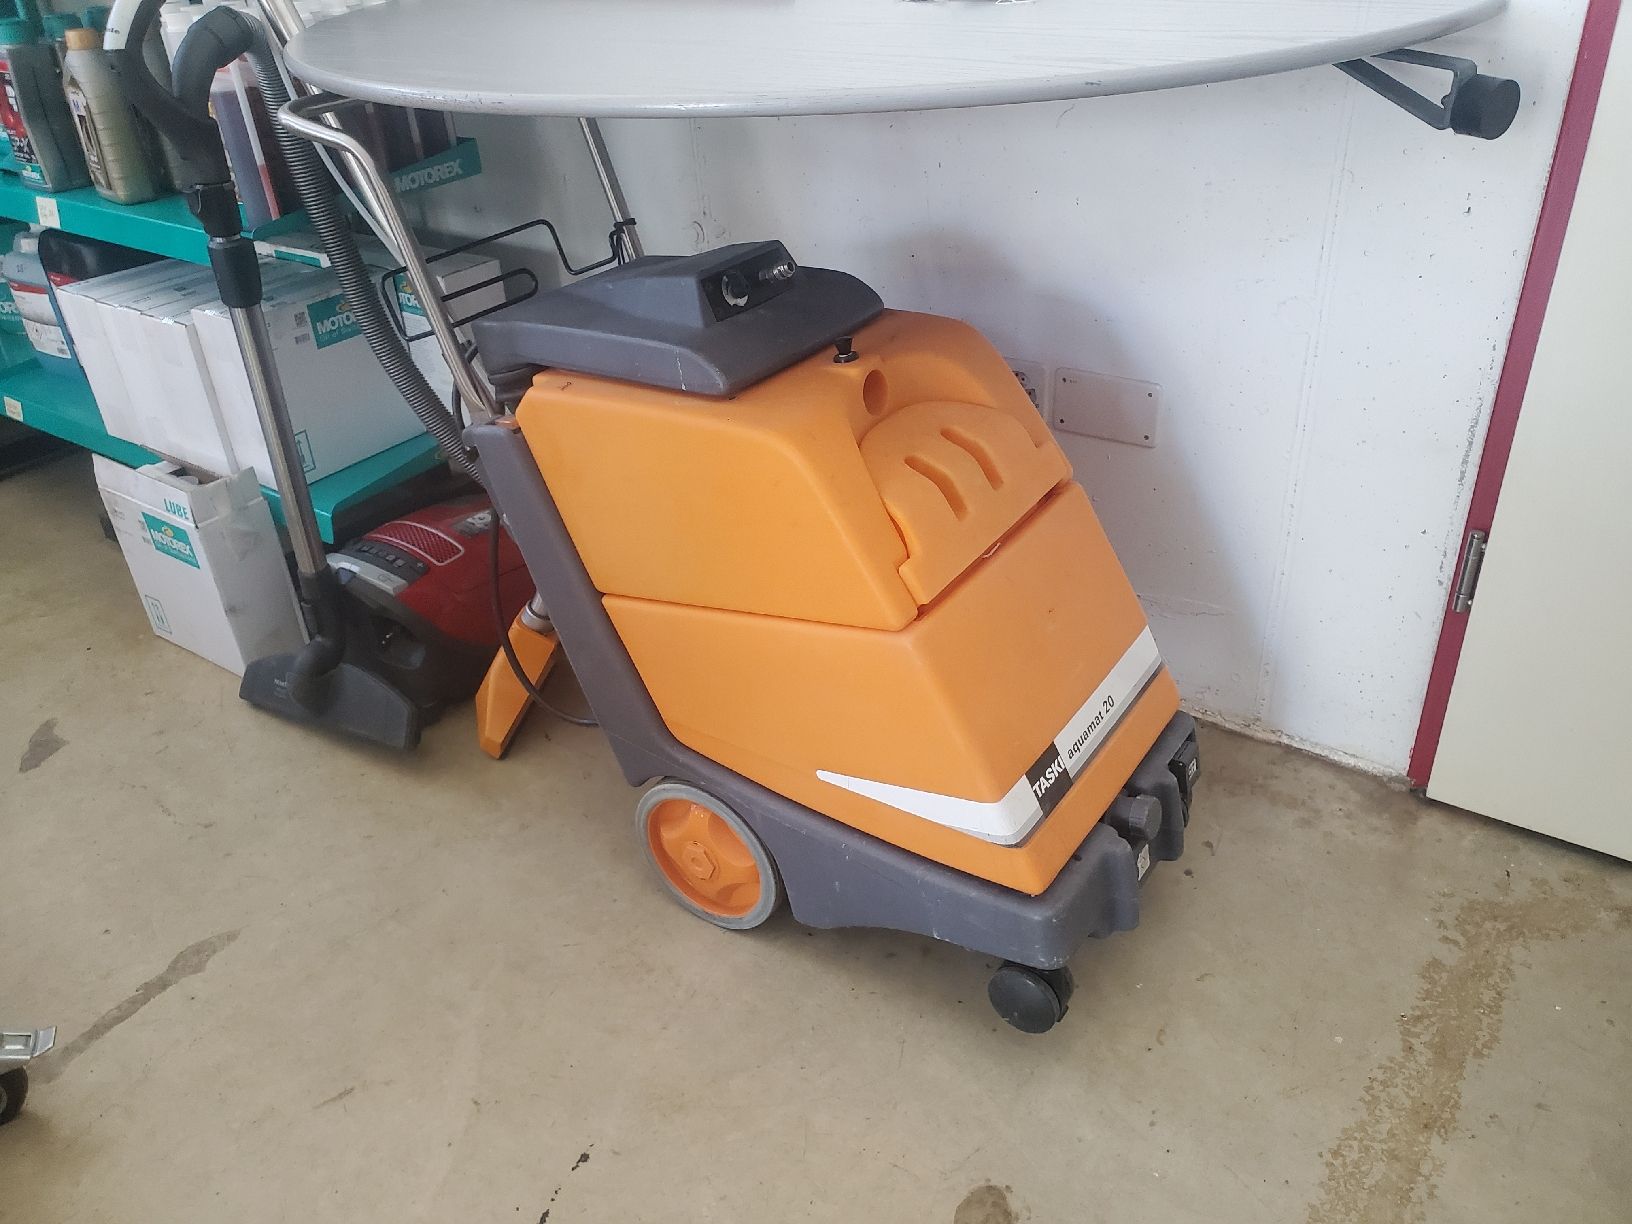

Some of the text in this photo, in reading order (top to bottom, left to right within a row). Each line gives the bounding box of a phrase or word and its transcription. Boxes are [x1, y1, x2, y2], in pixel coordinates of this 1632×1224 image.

[394, 159, 463, 193] MOTOREX
[316, 311, 357, 335] MOTO
[164, 498, 189, 520] LUBE
[1032, 695, 1115, 798] TASKI aquamat 20
